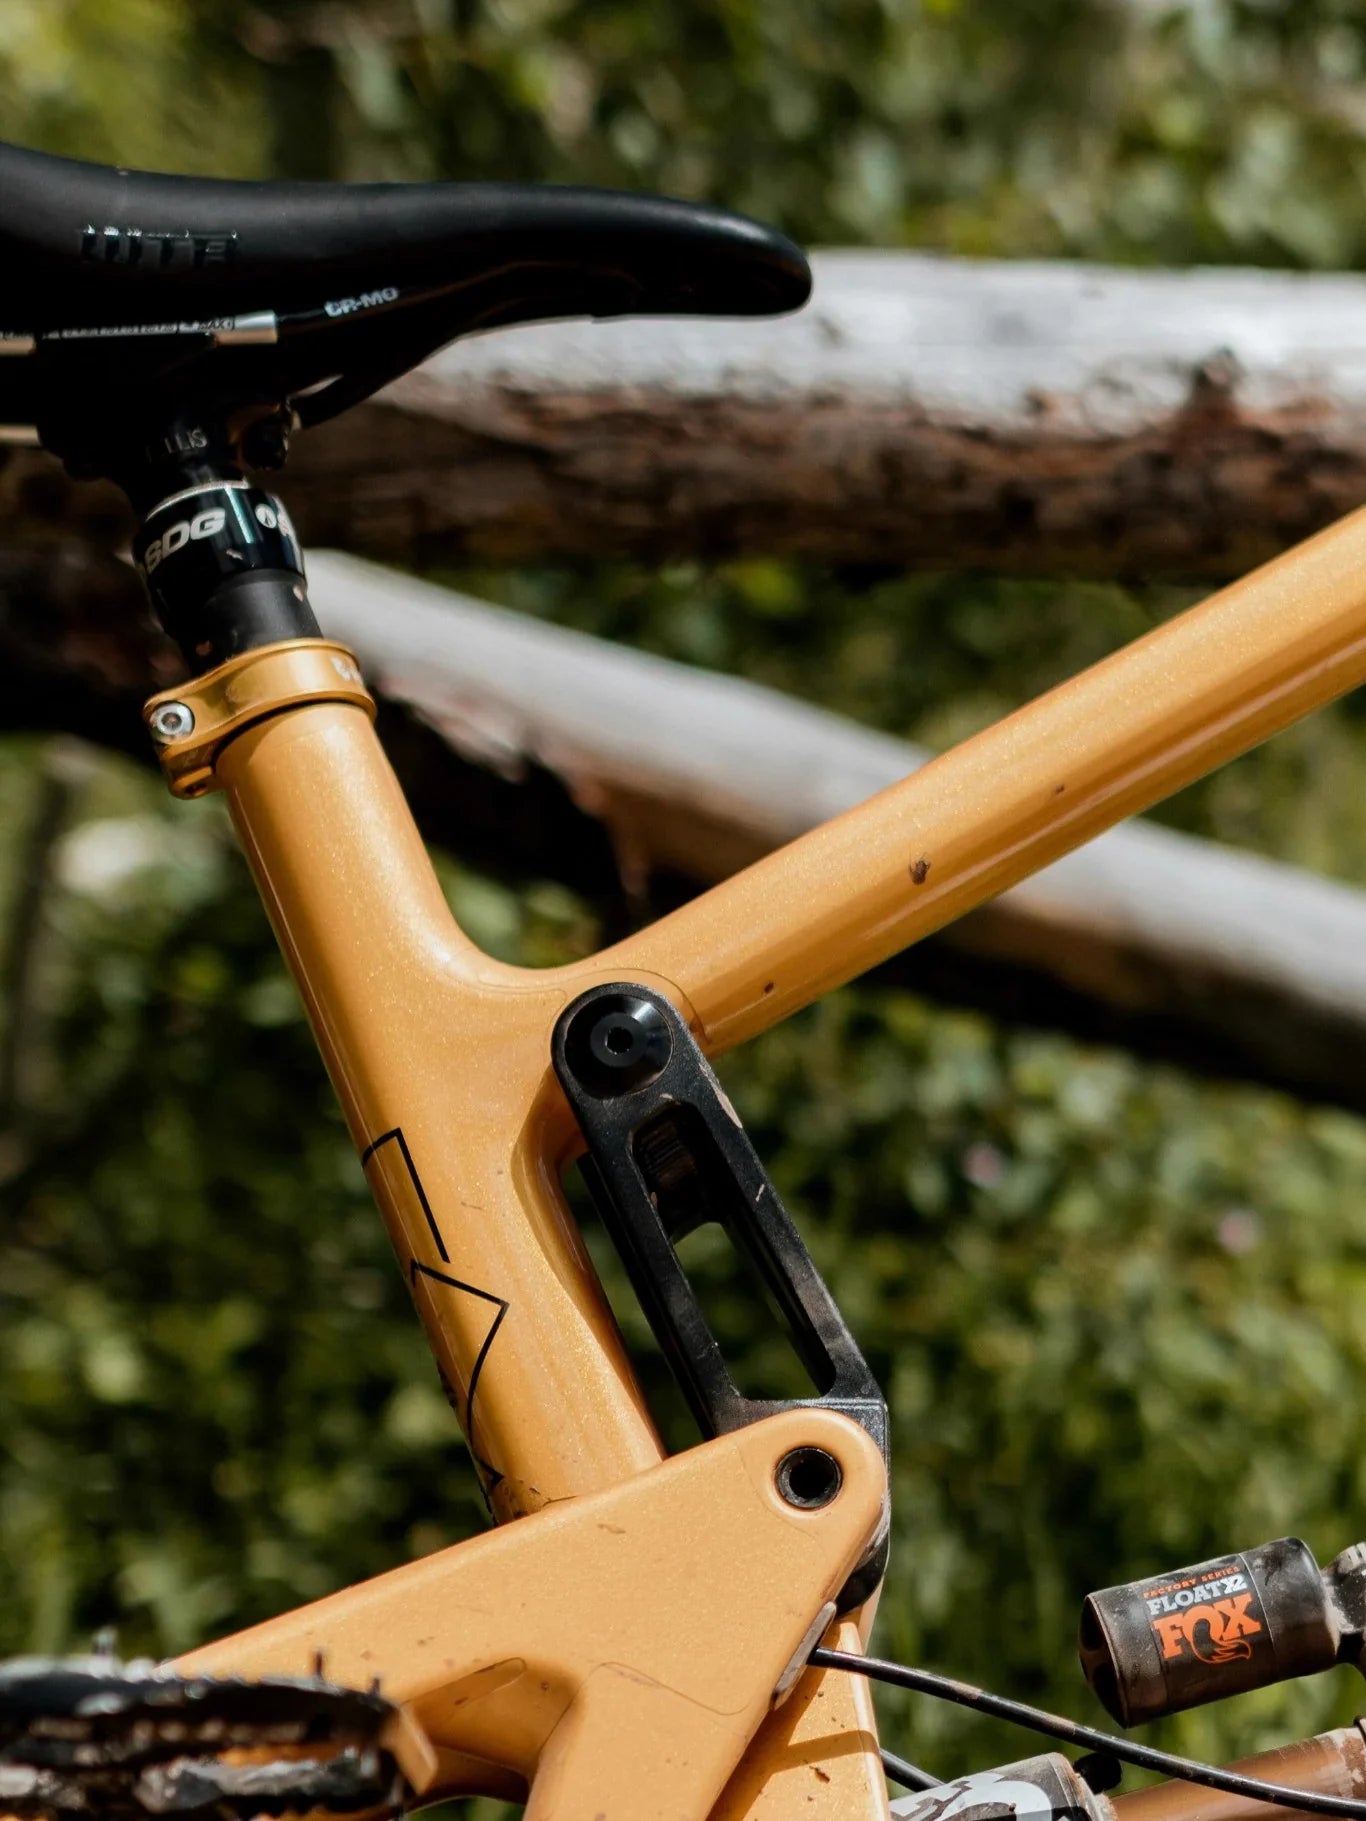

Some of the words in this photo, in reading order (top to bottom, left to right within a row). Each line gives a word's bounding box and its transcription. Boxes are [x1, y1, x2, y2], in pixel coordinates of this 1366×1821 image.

[324, 287, 399, 318] CR-MO
[144, 507, 226, 574] SDG
[1143, 1578, 1197, 1599] FACTORY
[1201, 1566, 1240, 1583] SERIES
[1153, 1592, 1261, 1664] FOX
